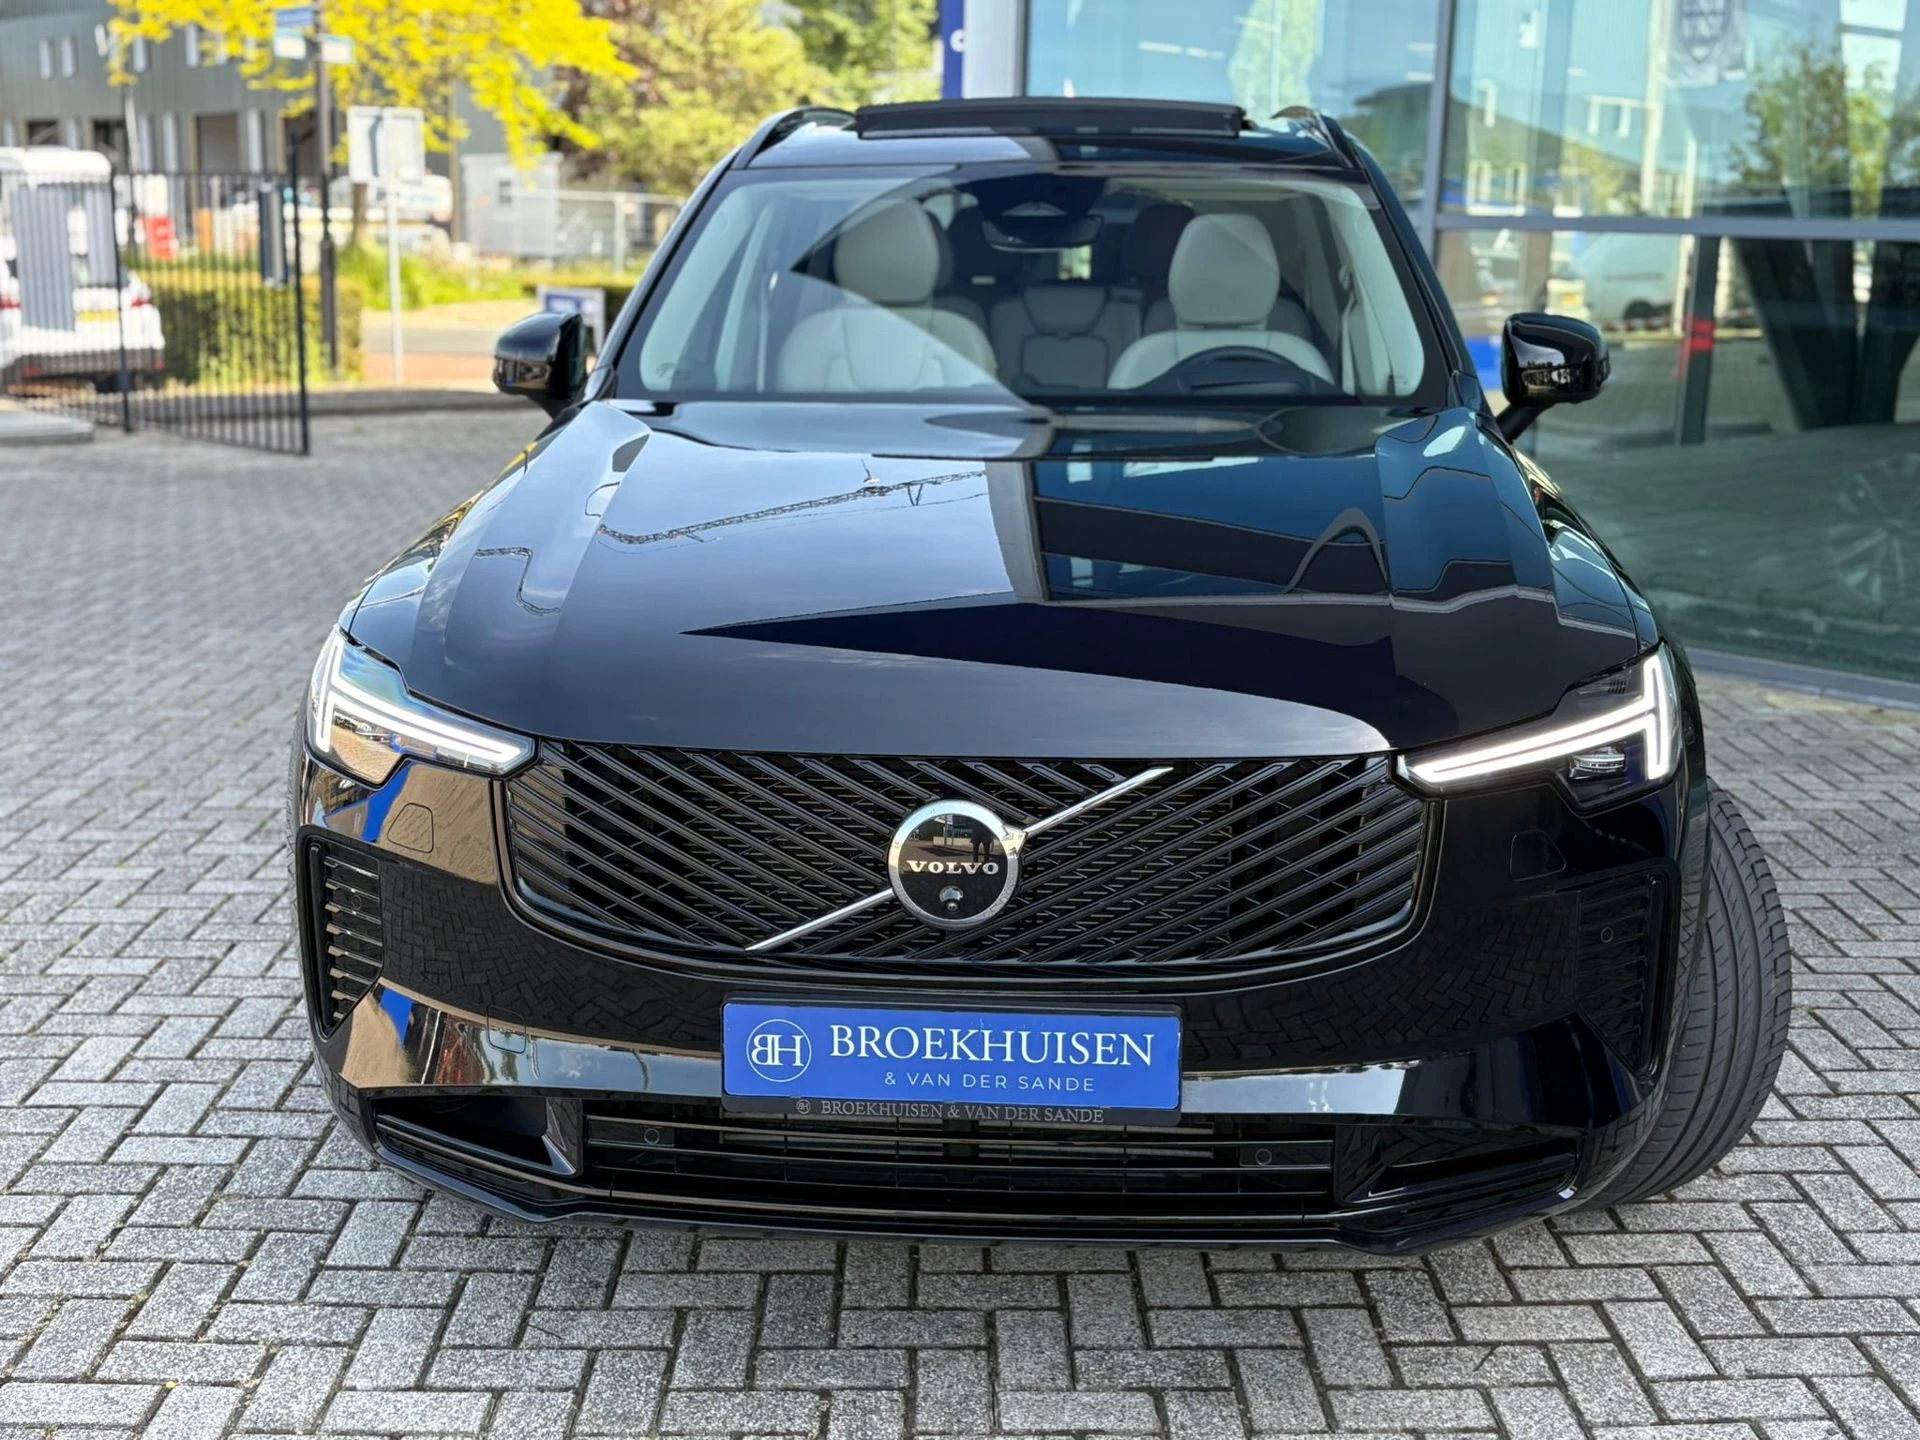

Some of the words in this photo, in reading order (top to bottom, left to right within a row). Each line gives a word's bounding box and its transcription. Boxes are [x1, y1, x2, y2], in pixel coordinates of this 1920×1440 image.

[906, 860, 999, 875] VOLVO
[829, 1024, 1155, 1067] BROEKHUISEN
[884, 1071, 897, 1086] &
[907, 1072, 951, 1087] VAN
[963, 1073, 1008, 1089] DER
[1017, 1075, 1095, 1092] SANDE
[820, 1100, 943, 1118] BROEKHUISEN
[947, 1104, 960, 1118] &
[964, 1105, 1000, 1120] VAN
[1005, 1106, 1041, 1121] DER
[1044, 1108, 1105, 1123] SANDE
